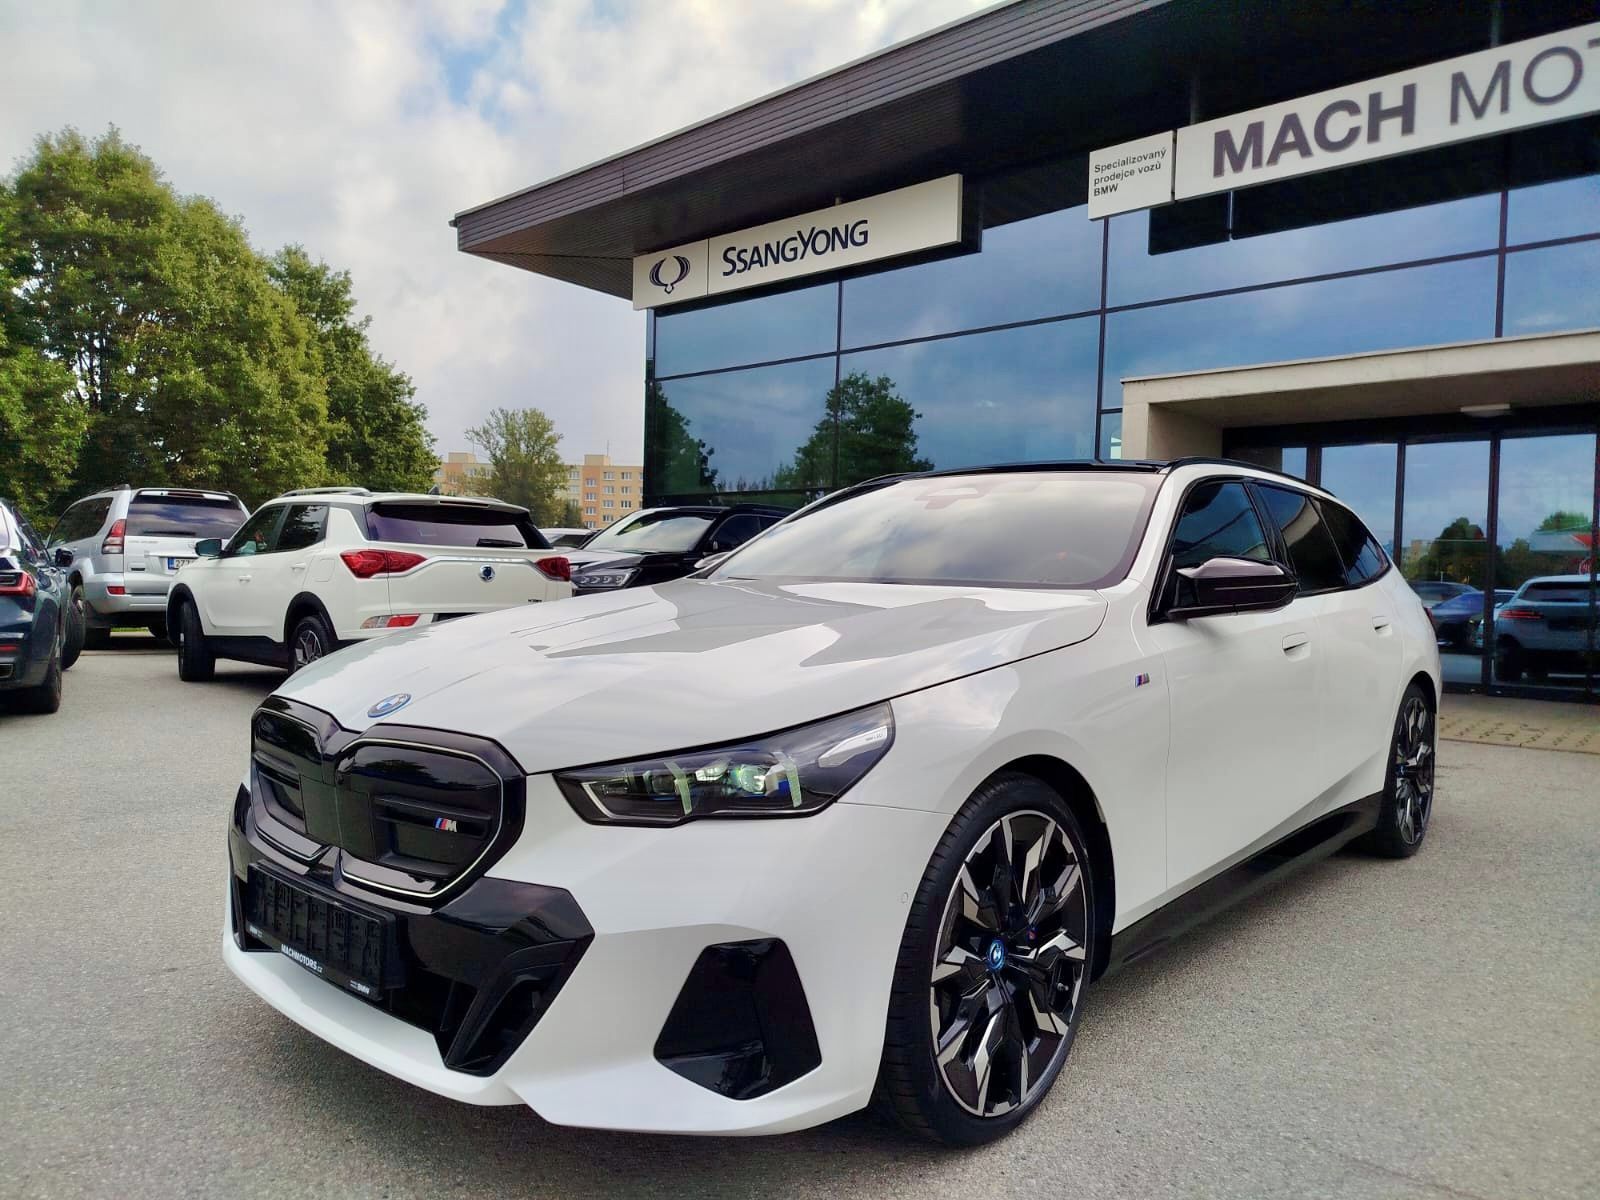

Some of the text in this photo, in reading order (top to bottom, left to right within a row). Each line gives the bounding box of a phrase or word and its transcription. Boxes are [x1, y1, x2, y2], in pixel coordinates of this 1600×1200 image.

[1212, 37, 1600, 178] MACH MO
[1094, 147, 1167, 173] Specializovaný
[1093, 161, 1161, 186] prodejce vozů
[1093, 183, 1119, 197] BMW
